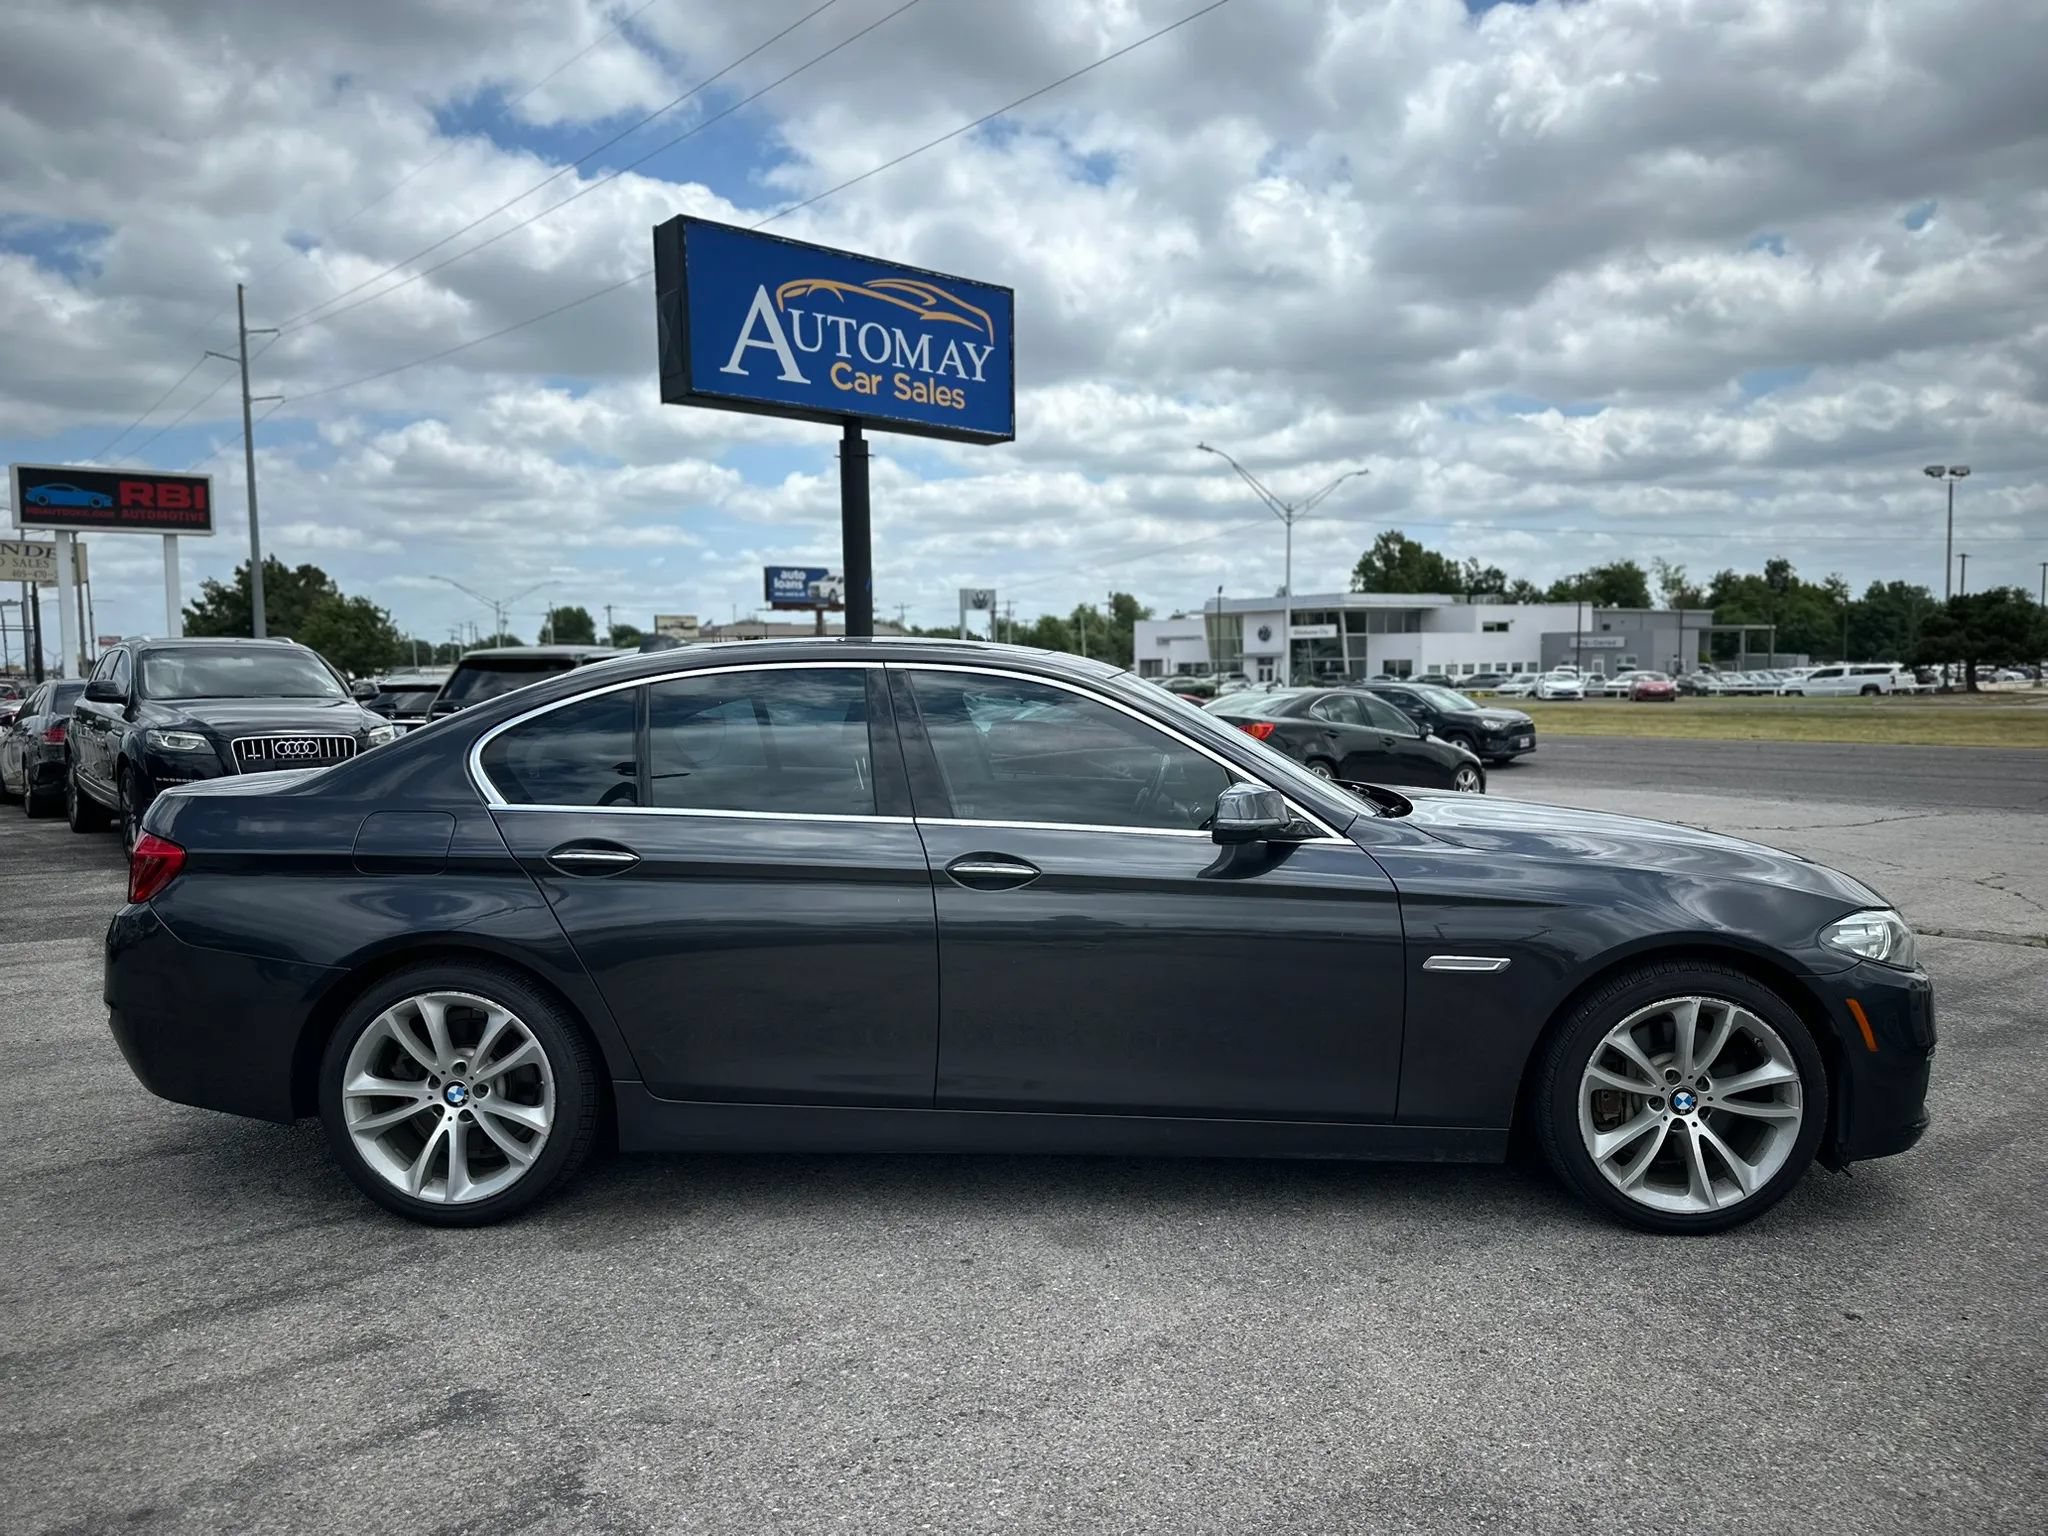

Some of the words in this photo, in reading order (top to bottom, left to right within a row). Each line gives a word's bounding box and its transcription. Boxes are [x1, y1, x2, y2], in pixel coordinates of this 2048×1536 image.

[719, 284, 995, 385] AUTOMAY
[830, 361, 882, 396] Car
[893, 373, 966, 410] Sales
[119, 480, 206, 509] RBI
[121, 508, 208, 523] AUTOMOTIVE
[12, 558, 50, 569] SALES
[780, 570, 806, 580] auto
[773, 576, 804, 590] loans
